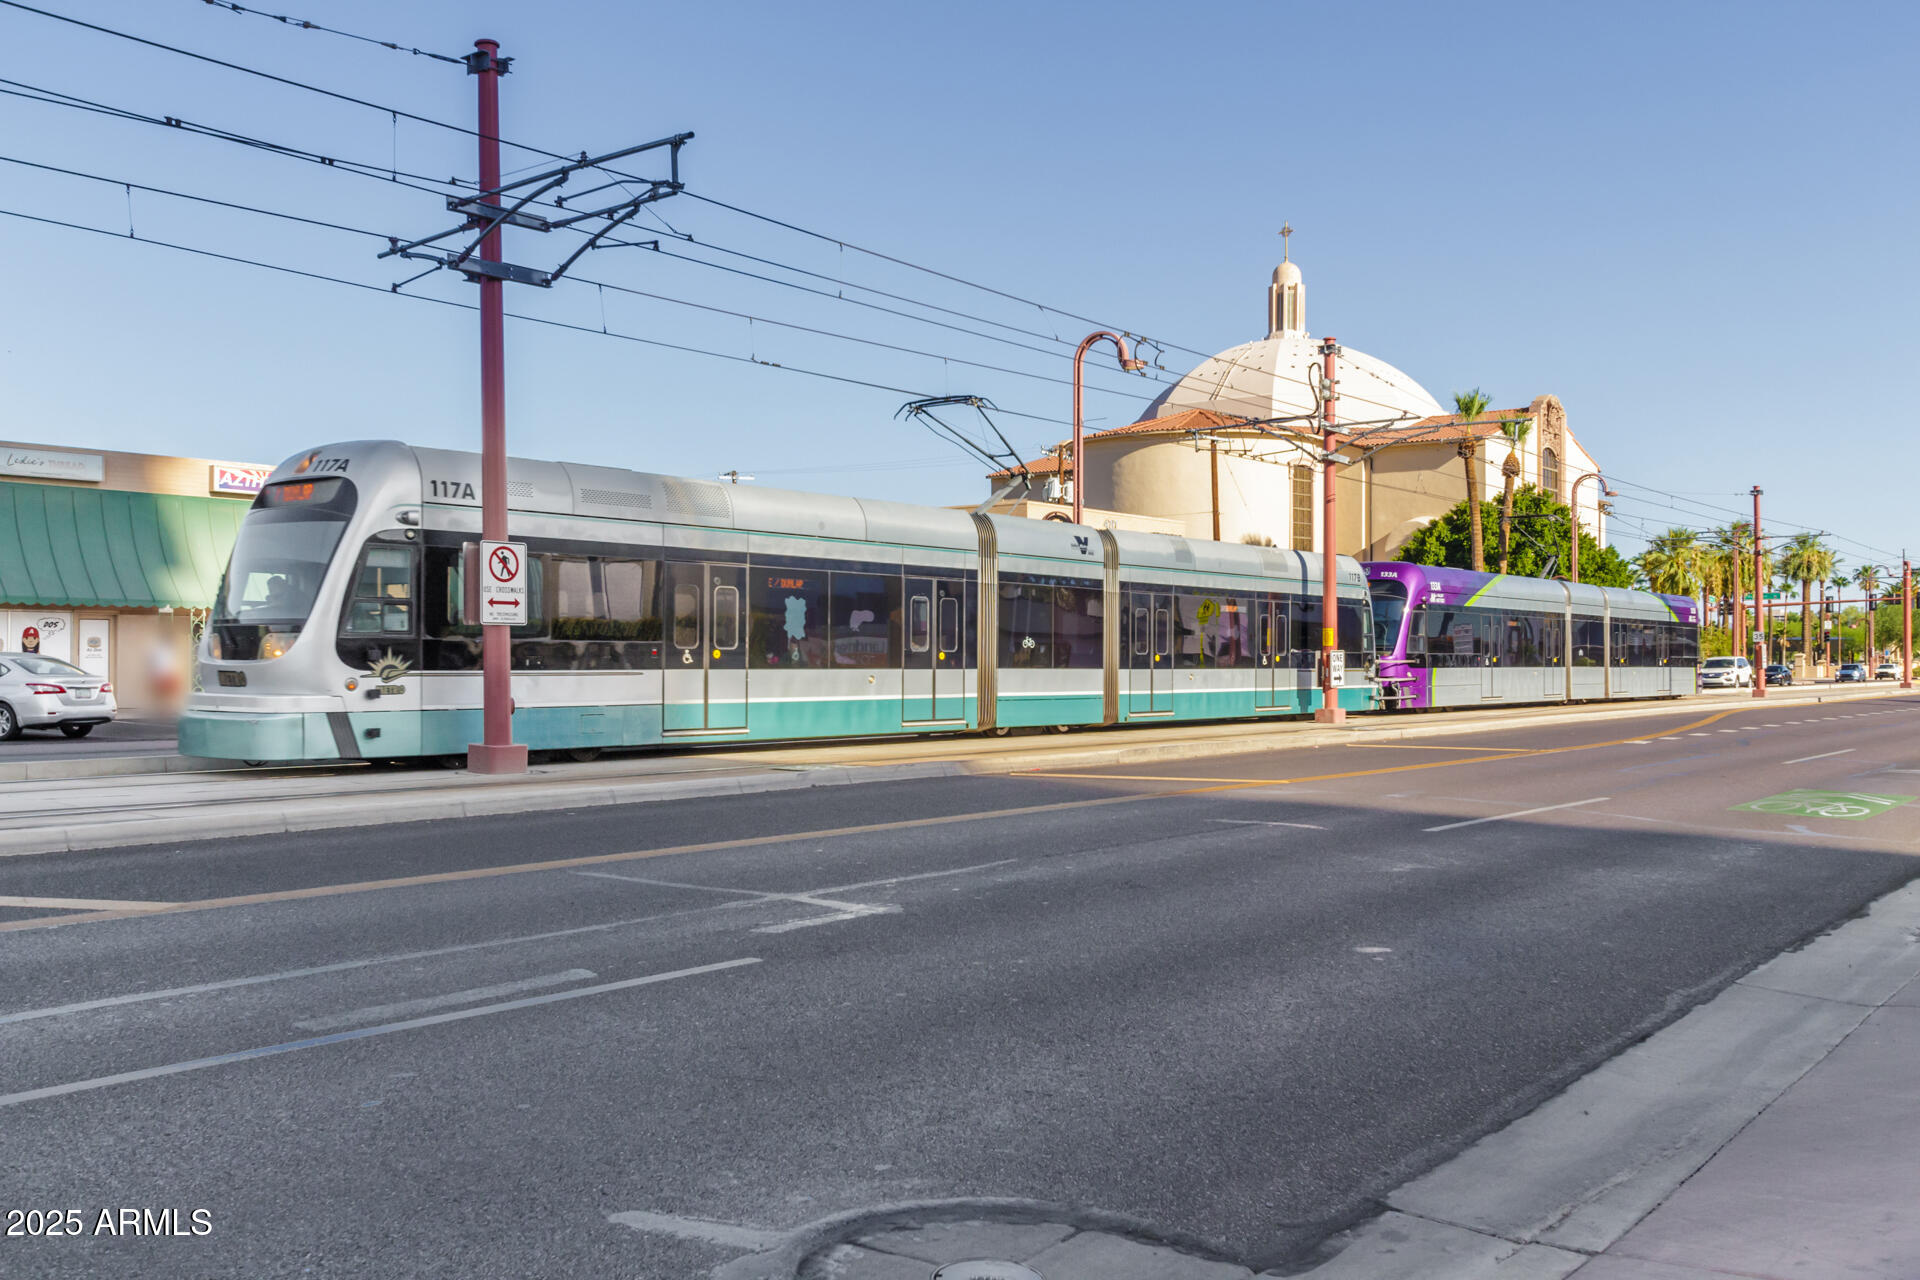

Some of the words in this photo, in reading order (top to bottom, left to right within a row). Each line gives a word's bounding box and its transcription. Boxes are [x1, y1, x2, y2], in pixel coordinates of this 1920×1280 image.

[313, 458, 350, 473] 117A
[430, 479, 476, 500] 117A
[1754, 633, 1764, 641] 35
[1333, 654, 1343, 663] ONE
[1332, 664, 1344, 673] WAY
